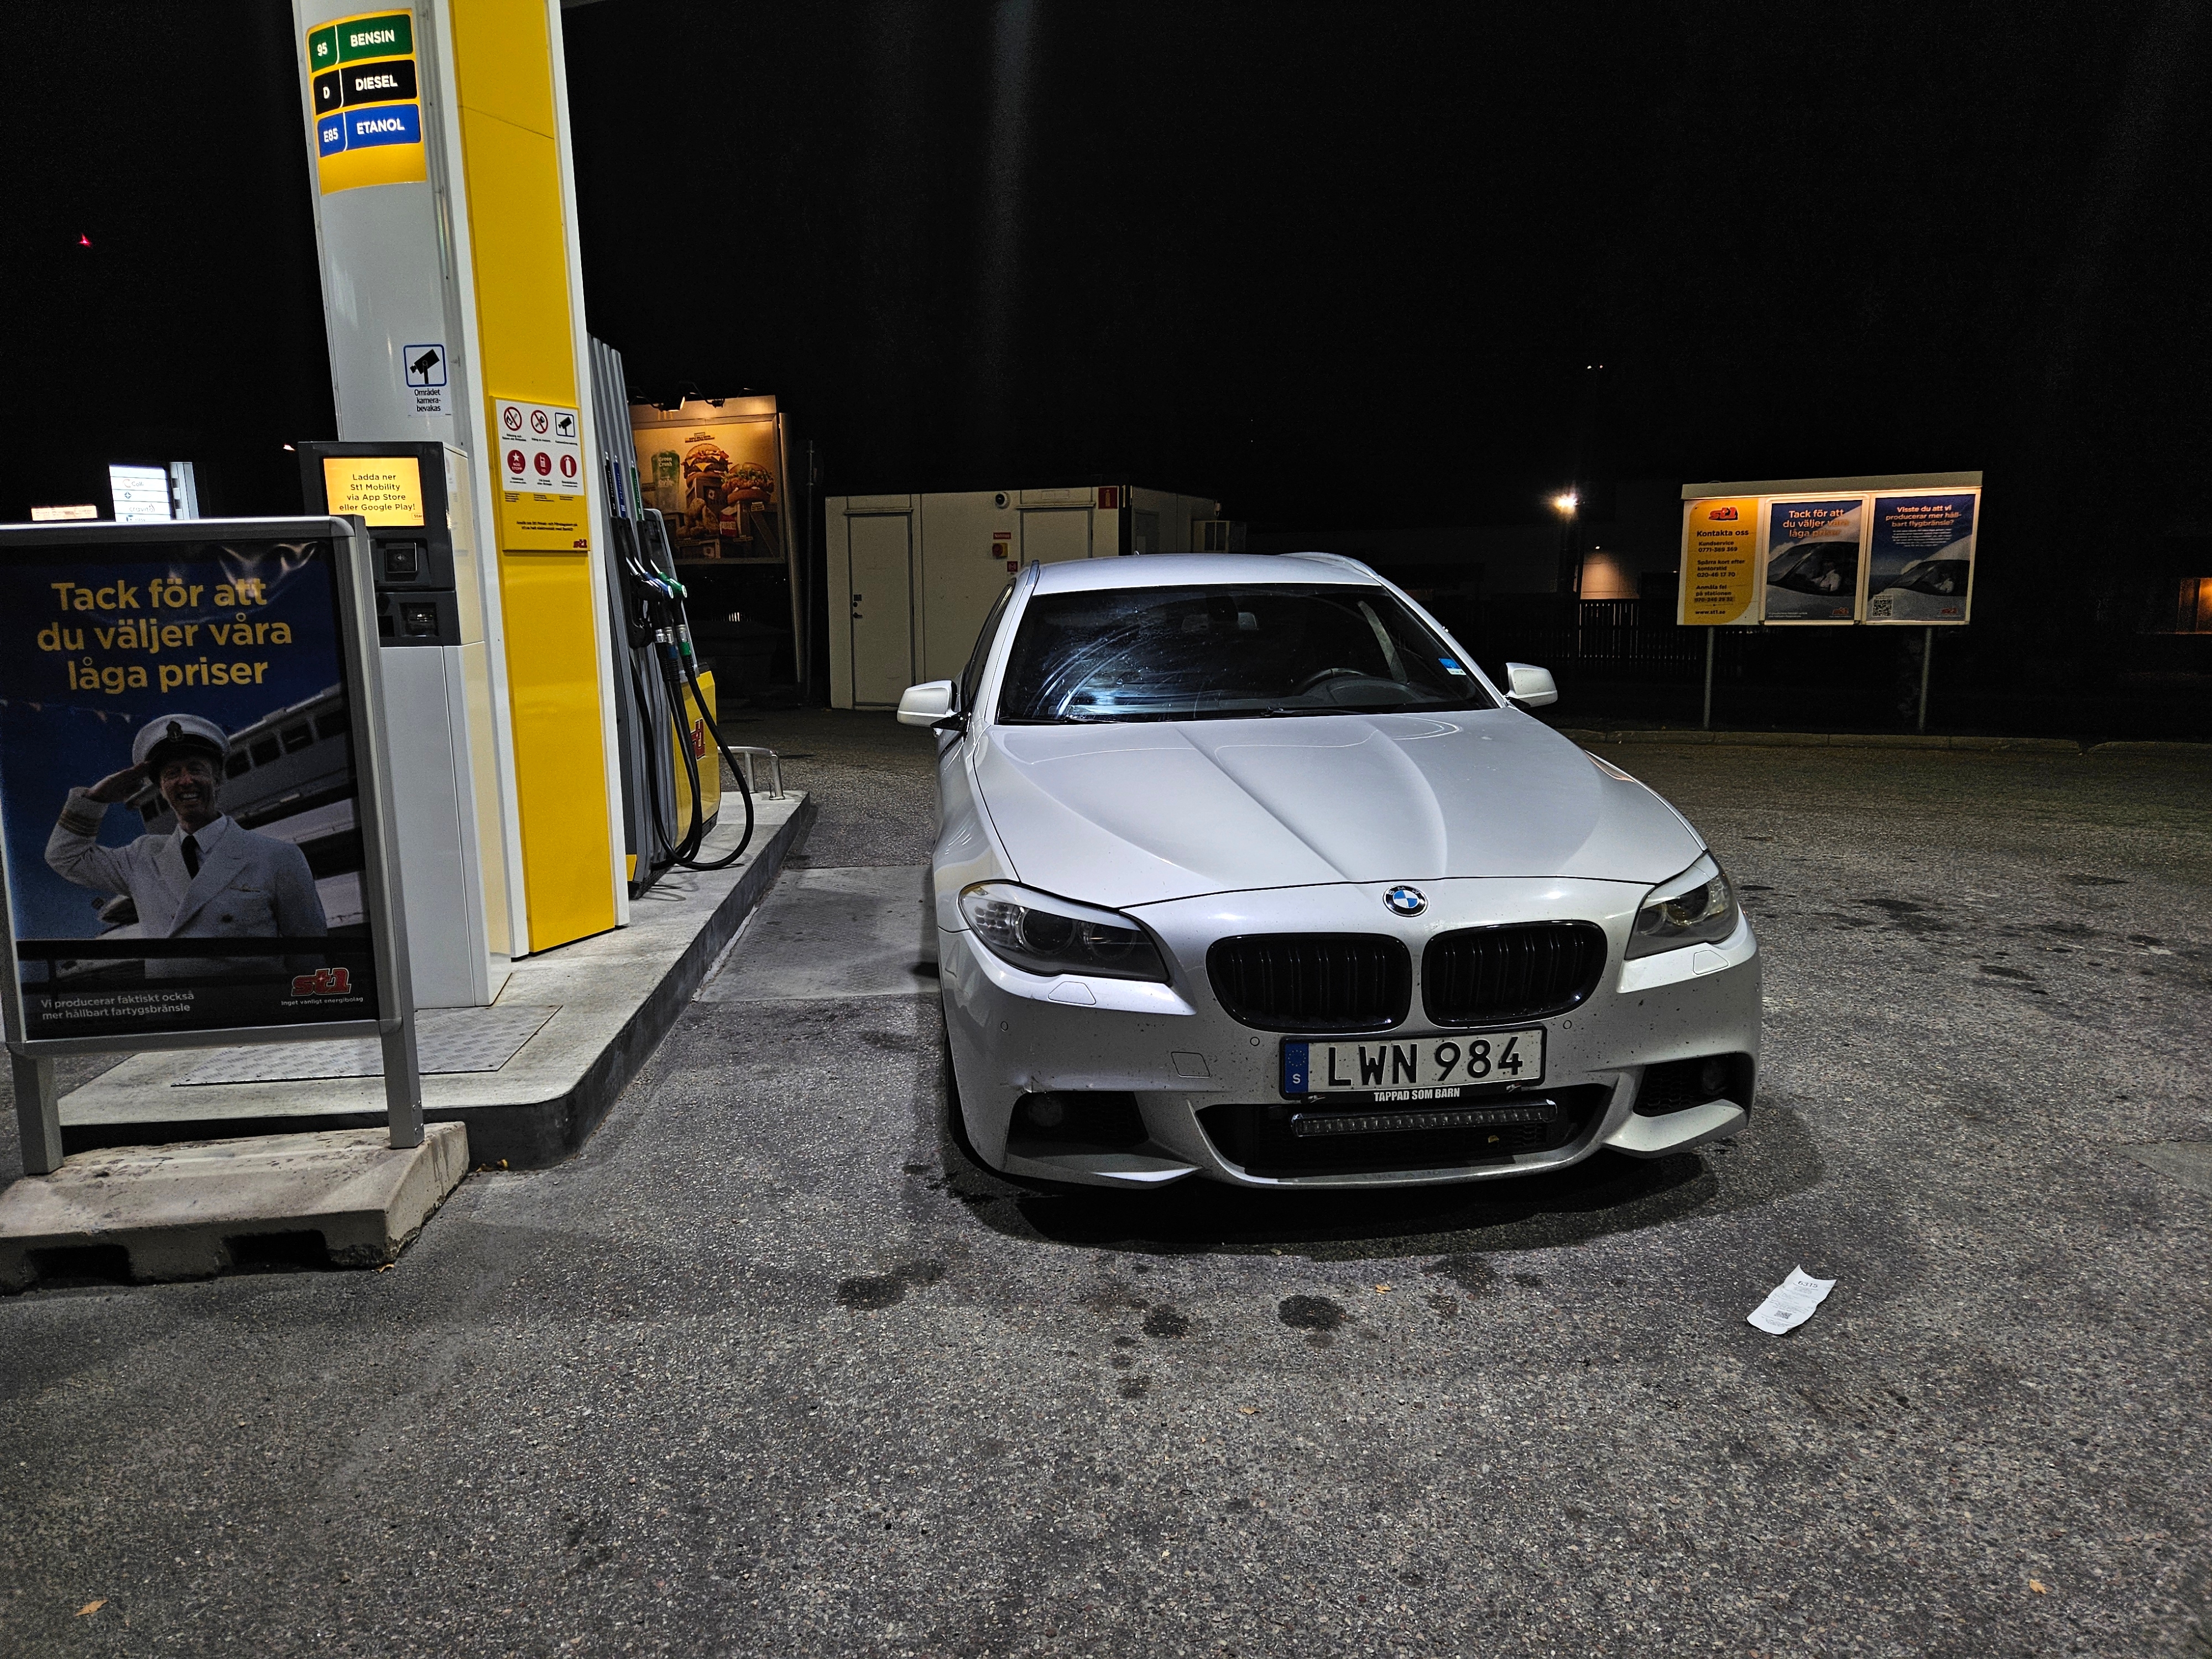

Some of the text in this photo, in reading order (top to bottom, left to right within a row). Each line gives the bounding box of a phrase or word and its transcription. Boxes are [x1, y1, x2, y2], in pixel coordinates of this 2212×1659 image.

[317, 29, 395, 56] 95 BENSIN
[323, 75, 398, 99] D DIESEL
[324, 118, 405, 143] E85 ETANOL
[1788, 510, 1811, 518] Tack
[1813, 509, 1828, 518] för
[1798, 519, 1825, 528] väljer
[1790, 529, 1810, 538] låga
[51, 578, 267, 611] Tack för att
[37, 612, 293, 654] du väljer våra
[68, 656, 269, 694] låga priser
[291, 968, 352, 997] st1
[41, 990, 194, 1009] Vi producerar faktiskt också
[42, 1003, 190, 1020] mer hållbart fartygsbränsle
[1328, 1036, 1524, 1086] LWN 984
[1292, 1073, 1301, 1084] S
[1374, 1087, 1460, 1102] TAPPAD SOM BARN
